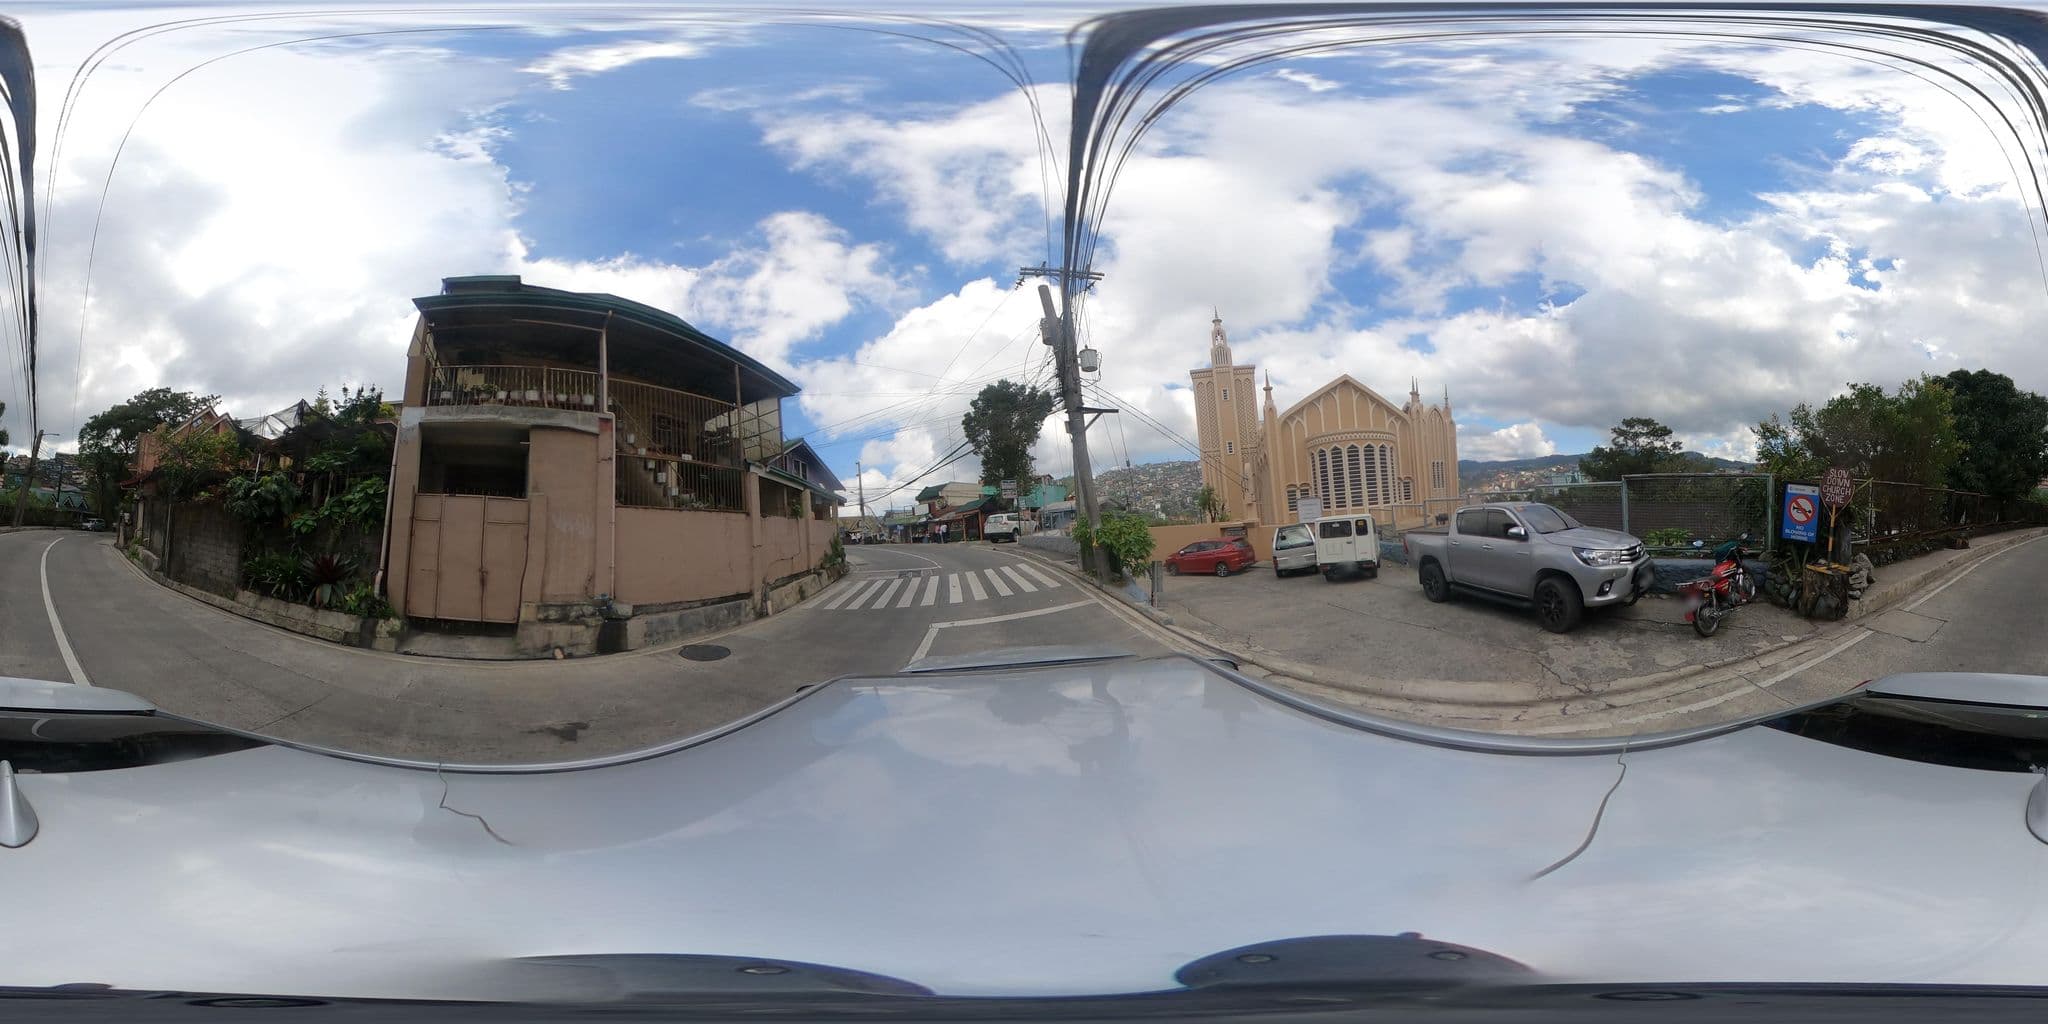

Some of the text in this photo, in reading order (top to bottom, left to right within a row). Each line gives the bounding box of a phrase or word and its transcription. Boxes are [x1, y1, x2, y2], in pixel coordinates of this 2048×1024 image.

[1830, 468, 1849, 478] SLOW
[1826, 477, 1851, 487] DOWN
[1823, 485, 1851, 496] CHURCH
[1825, 494, 1845, 504] ZONE
